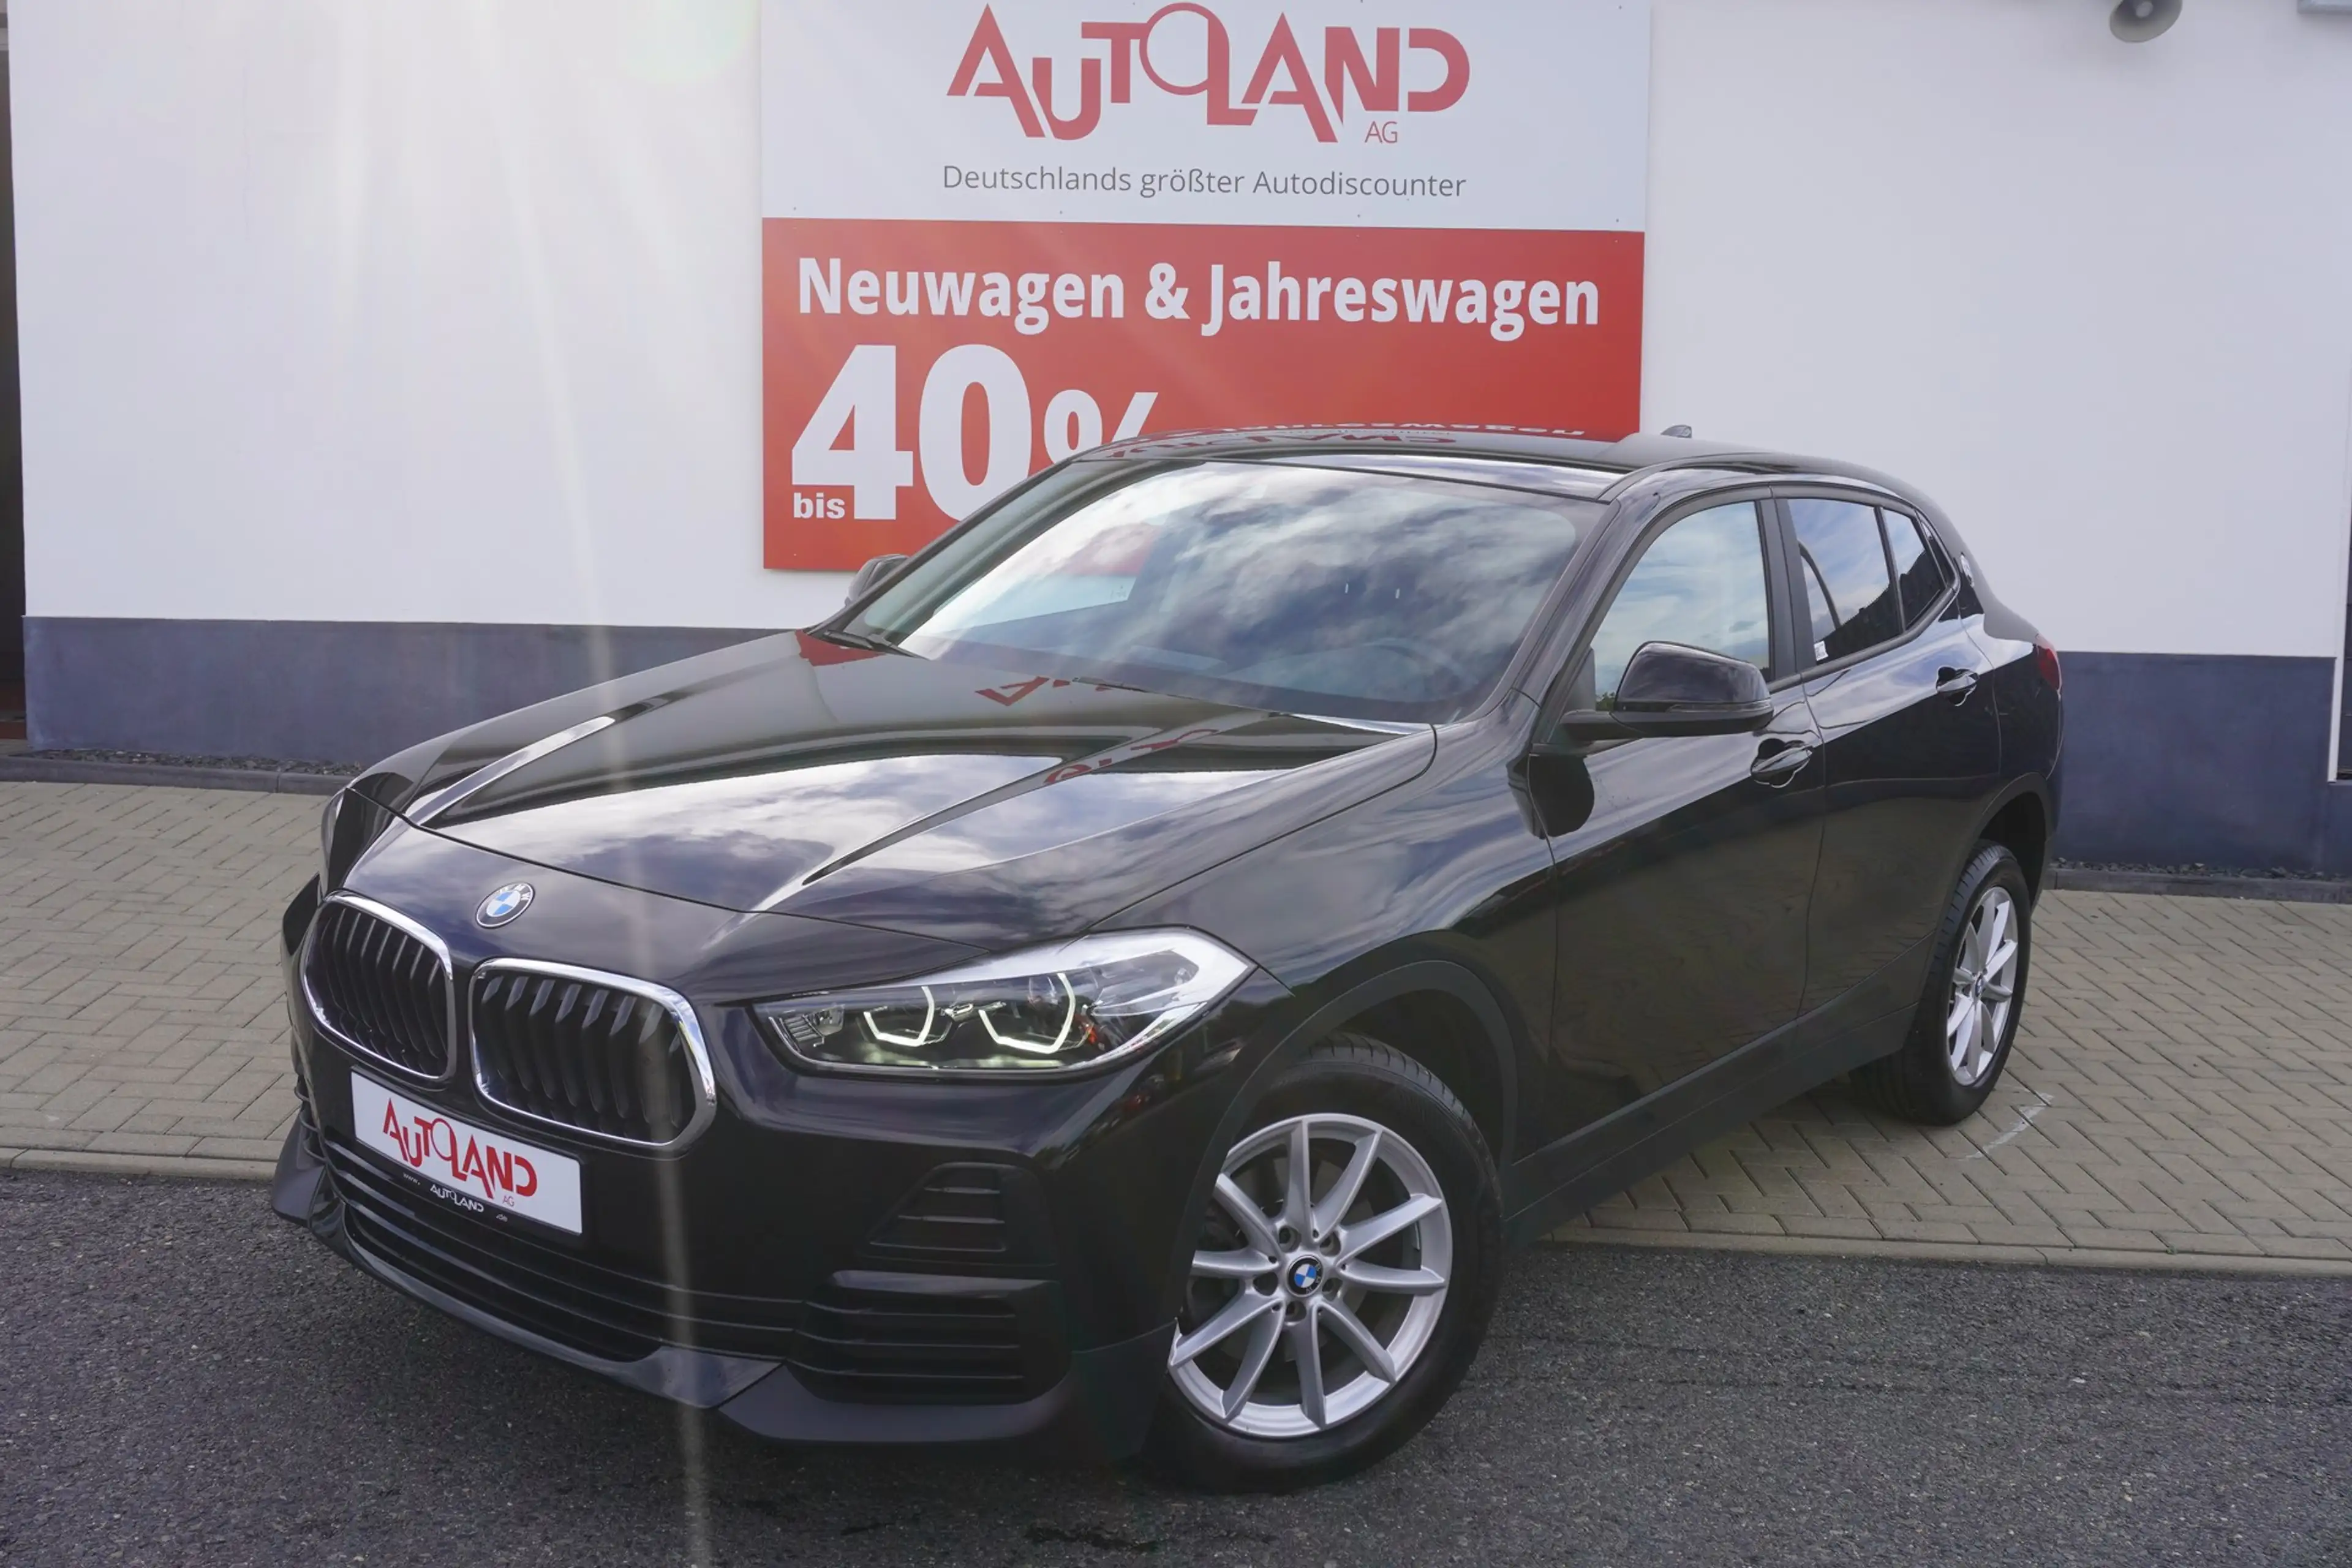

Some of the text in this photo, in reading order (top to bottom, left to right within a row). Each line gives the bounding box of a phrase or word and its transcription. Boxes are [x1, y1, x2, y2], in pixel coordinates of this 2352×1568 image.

[947, 2, 1470, 143] AUTOLAND
[1364, 120, 1398, 144] AG
[943, 165, 1467, 198] Deutschlands größter Autodiscounter
[798, 257, 1599, 342] Neuwagen & Jahreswagen
[792, 492, 846, 520] bis
[383, 1098, 538, 1199] AUTOLAND
[502, 1194, 515, 1207] AG
